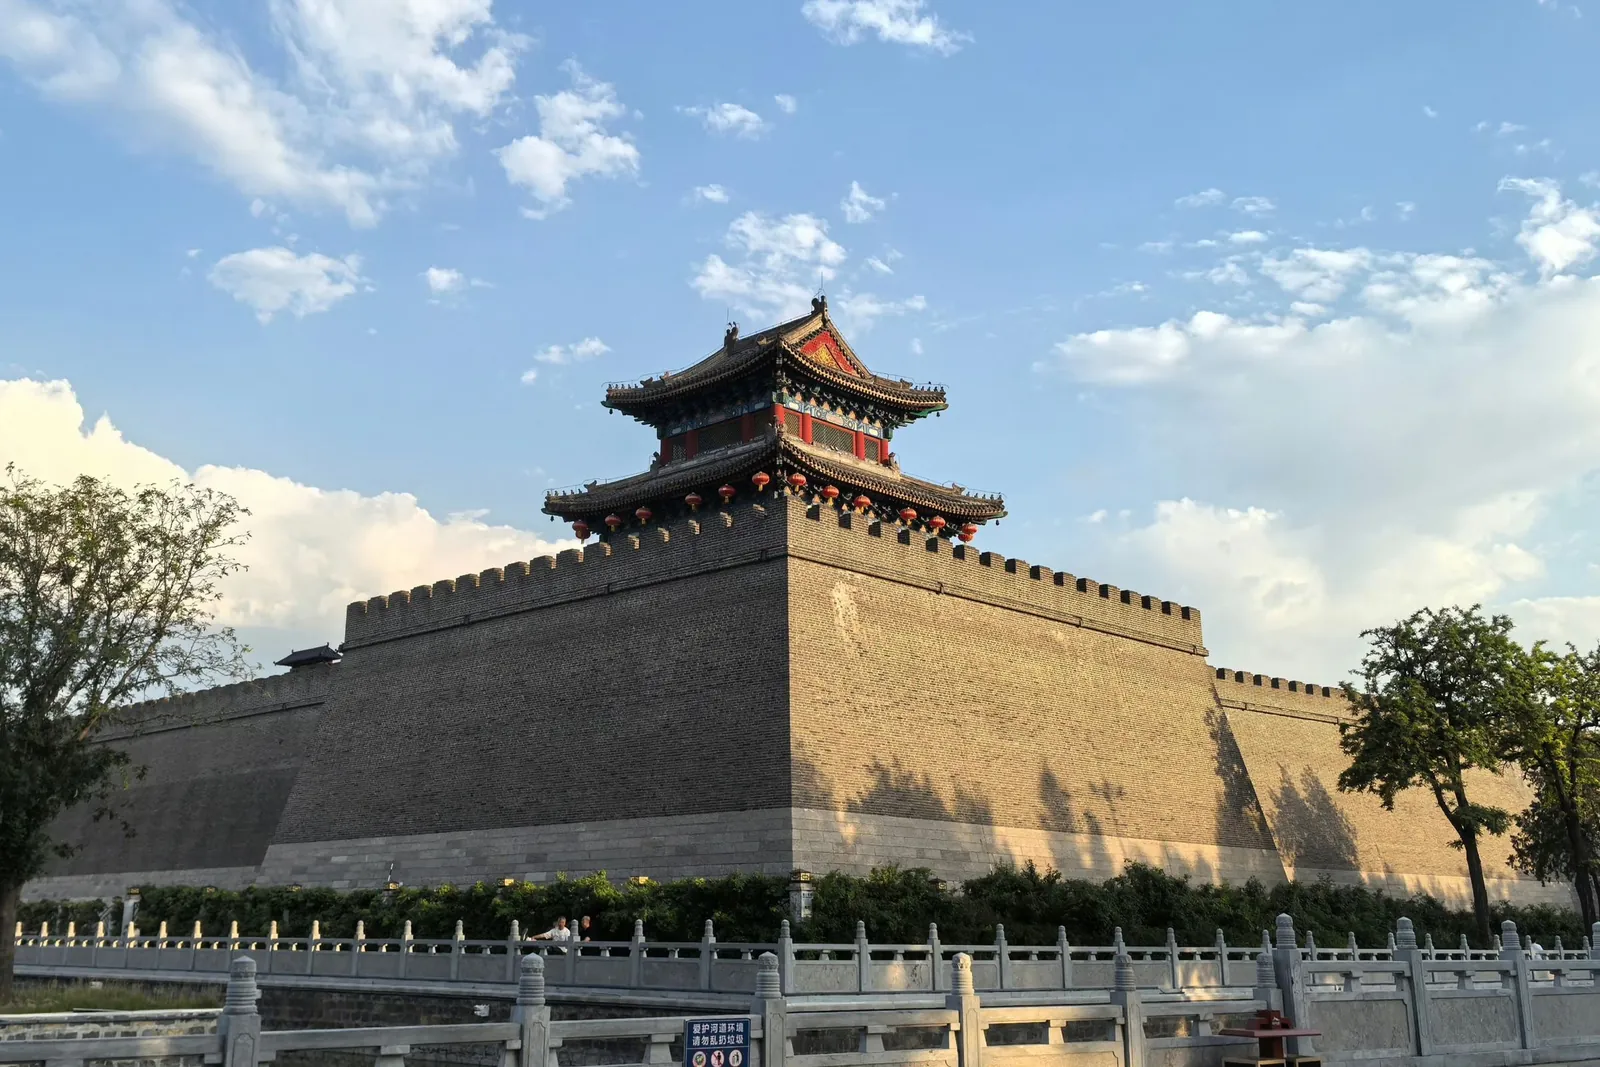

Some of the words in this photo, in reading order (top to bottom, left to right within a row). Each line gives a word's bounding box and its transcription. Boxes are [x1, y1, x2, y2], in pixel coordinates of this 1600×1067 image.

[692, 1022, 744, 1034] 爱护河道环境
[692, 1034, 744, 1046] 请勿乱扔垃圾
